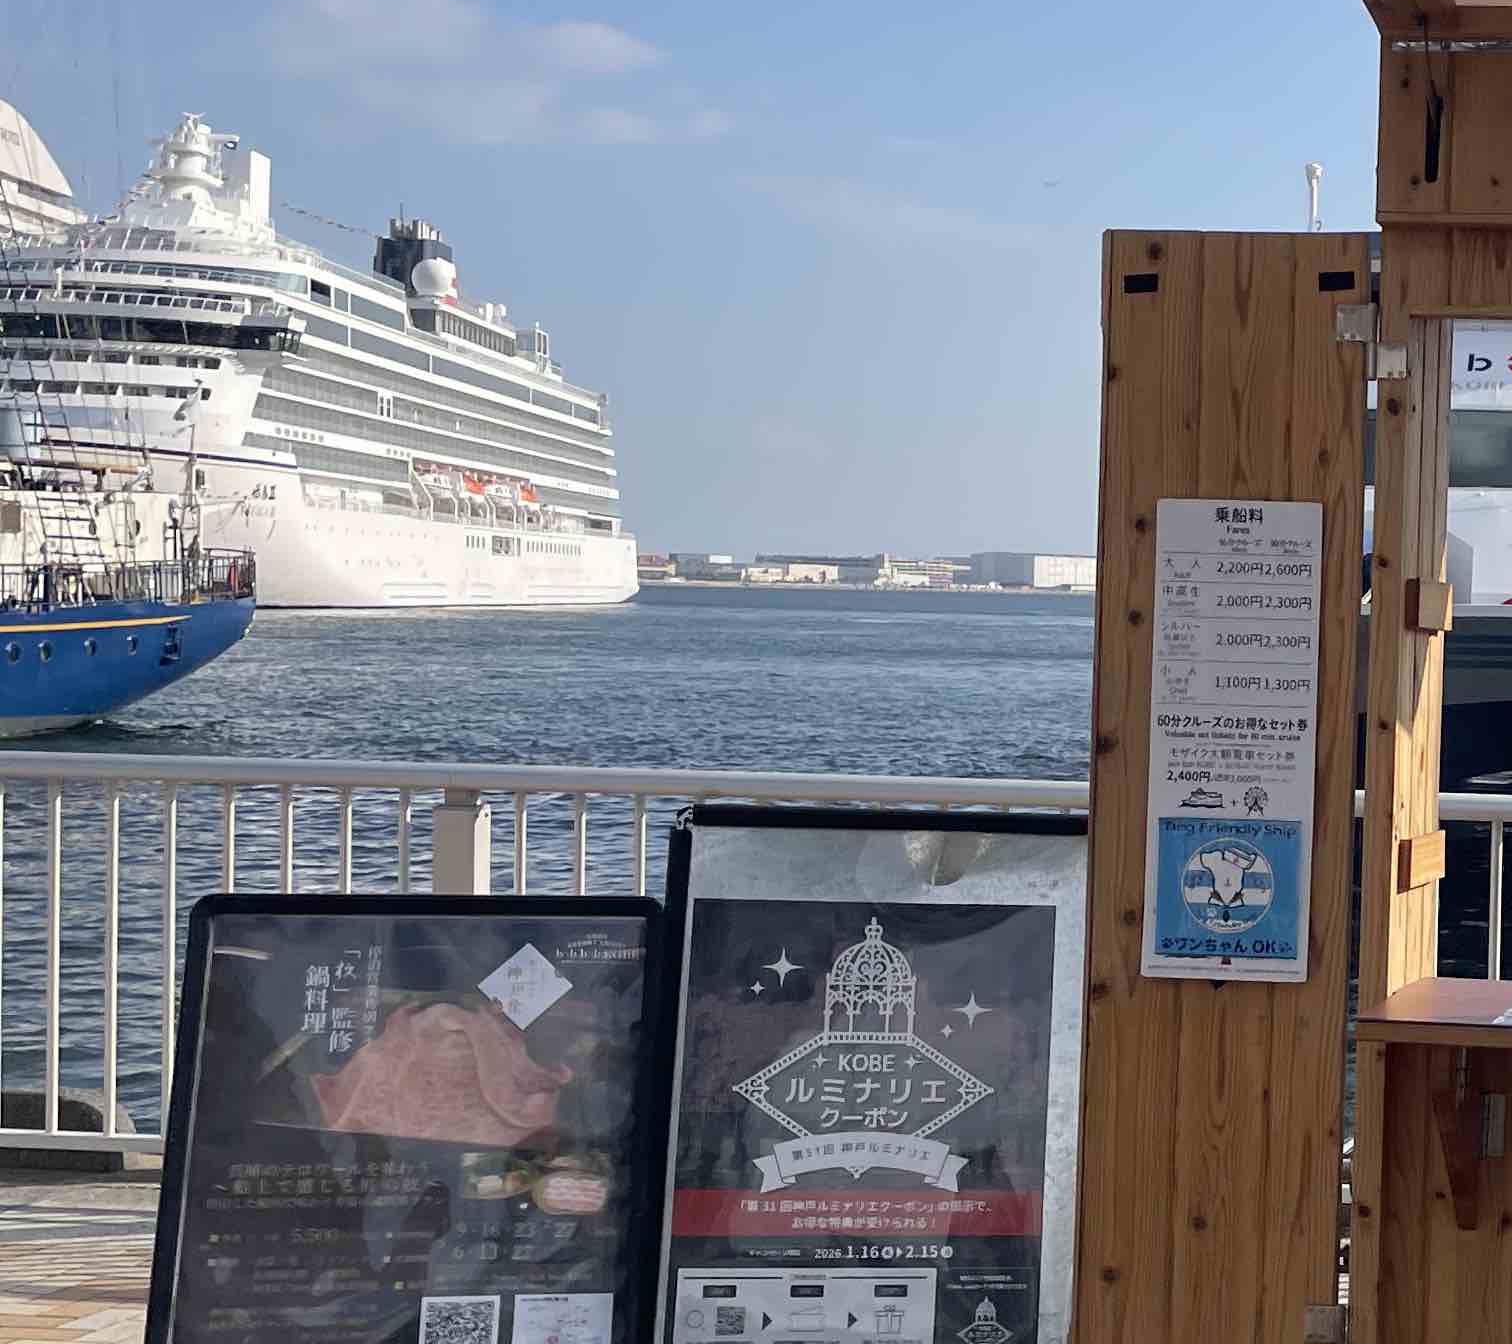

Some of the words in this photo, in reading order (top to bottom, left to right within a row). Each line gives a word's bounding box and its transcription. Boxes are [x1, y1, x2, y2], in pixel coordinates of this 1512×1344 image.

[1215, 507, 1264, 524] 乗船料
[1216, 560, 1263, 576] 2,200円
[1264, 563, 1313, 577] 2,600円
[1216, 594, 1263, 608] 2,000円
[1264, 595, 1313, 610] 2,300円
[1215, 632, 1262, 647] 2,000円
[1263, 635, 1311, 649] 2,300円
[1215, 675, 1261, 691] 1,100円
[1263, 678, 1311, 693] 1,300円
[1167, 770, 1212, 784] 2,400円
[301, 964, 330, 1035] 鍋料理
[838, 1053, 896, 1073] KOBE
[785, 1077, 946, 1104] ルミナリエ
[820, 1106, 908, 1128] クーポン
[840, 1142, 931, 1161] 神戸ルミナリエ
